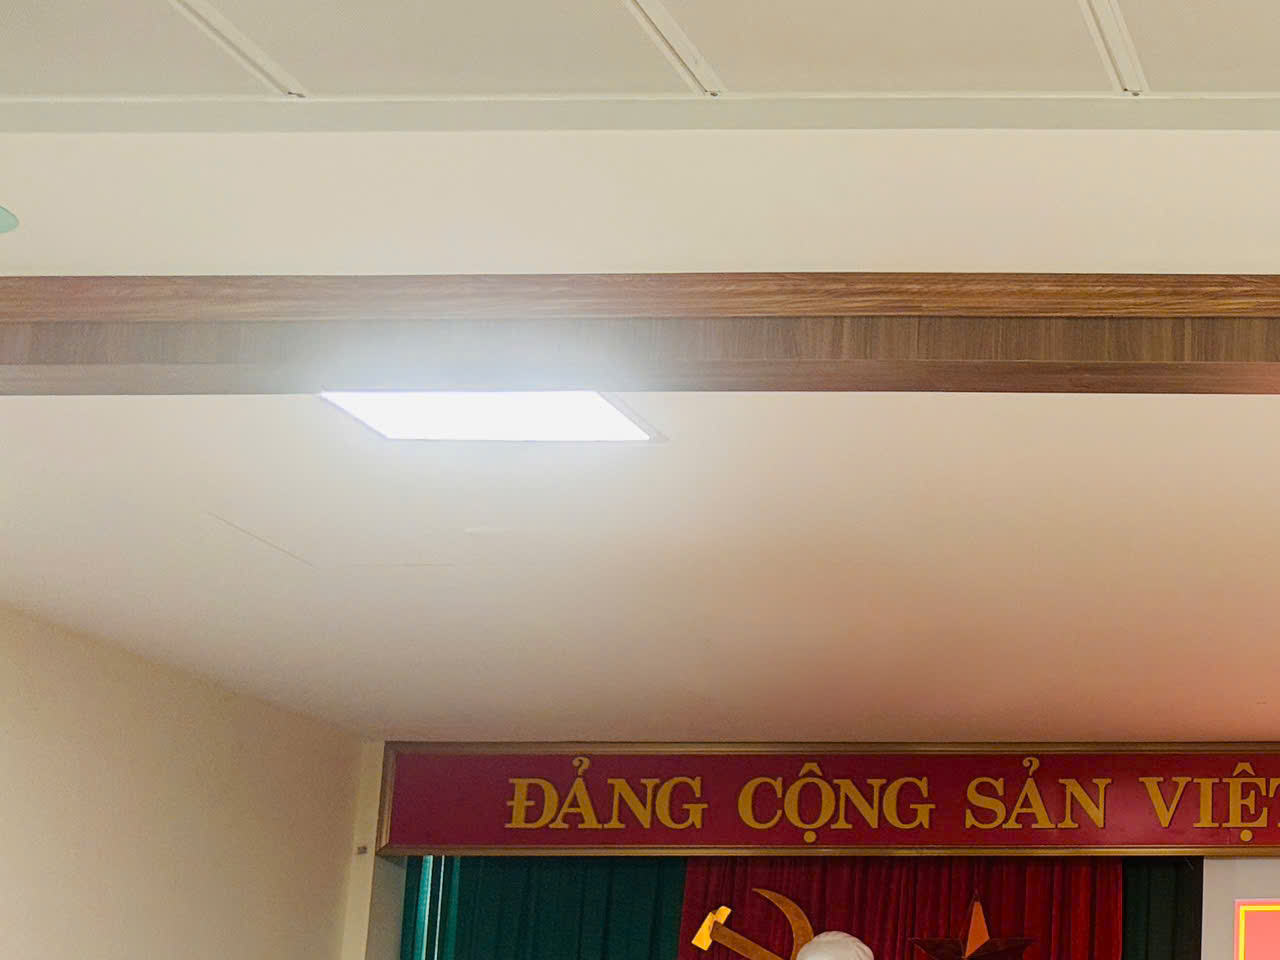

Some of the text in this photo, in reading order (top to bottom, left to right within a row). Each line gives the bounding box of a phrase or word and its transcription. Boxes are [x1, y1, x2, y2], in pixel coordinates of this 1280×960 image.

[505, 757, 708, 830] ĐẢNG
[738, 763, 936, 844] CỘNG
[965, 757, 1112, 829] SẢN
